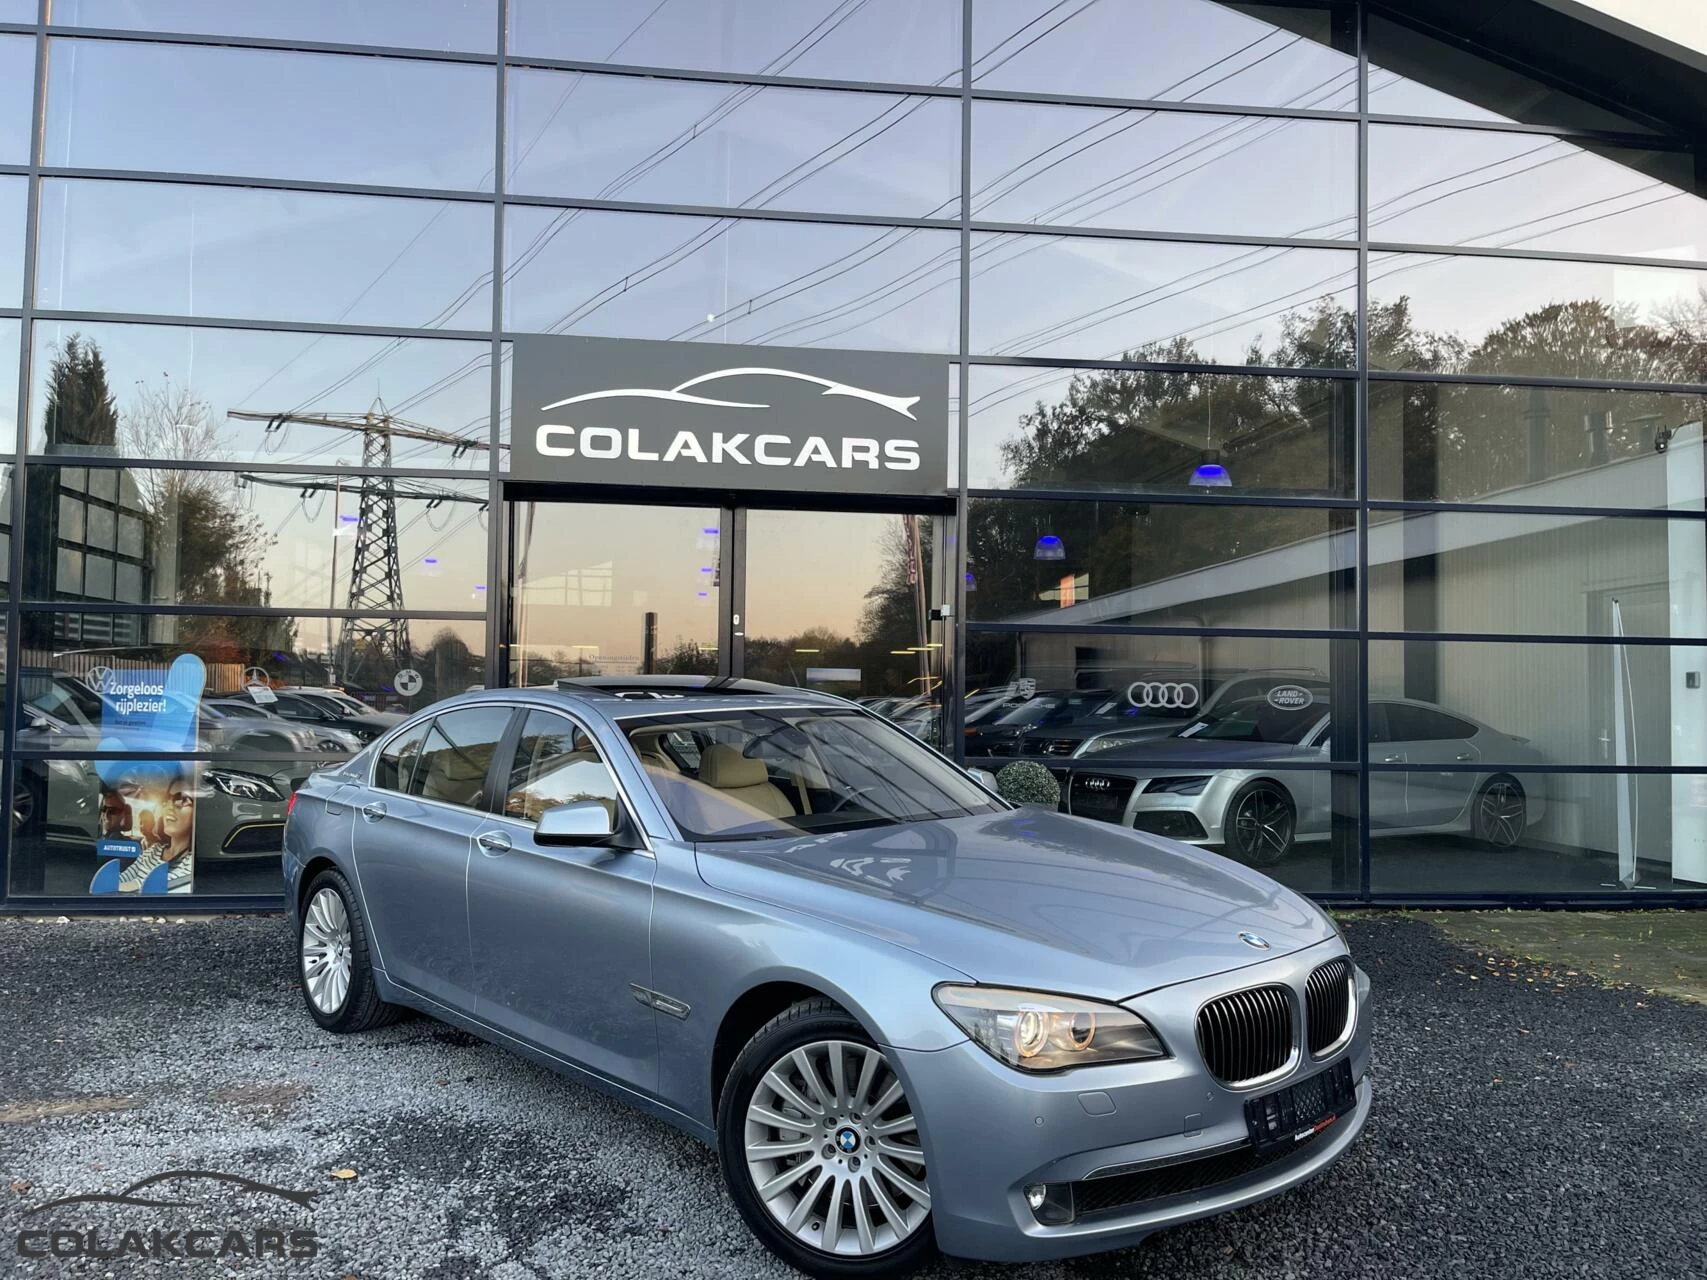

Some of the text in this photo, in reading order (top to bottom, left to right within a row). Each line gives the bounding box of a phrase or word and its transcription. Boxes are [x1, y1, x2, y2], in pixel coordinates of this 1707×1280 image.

[535, 424, 921, 471] COLAKCARS
[110, 682, 164, 698] Zorgeloos
[115, 698, 167, 715] rijplezier!
[1278, 697, 1305, 705] ROVER
